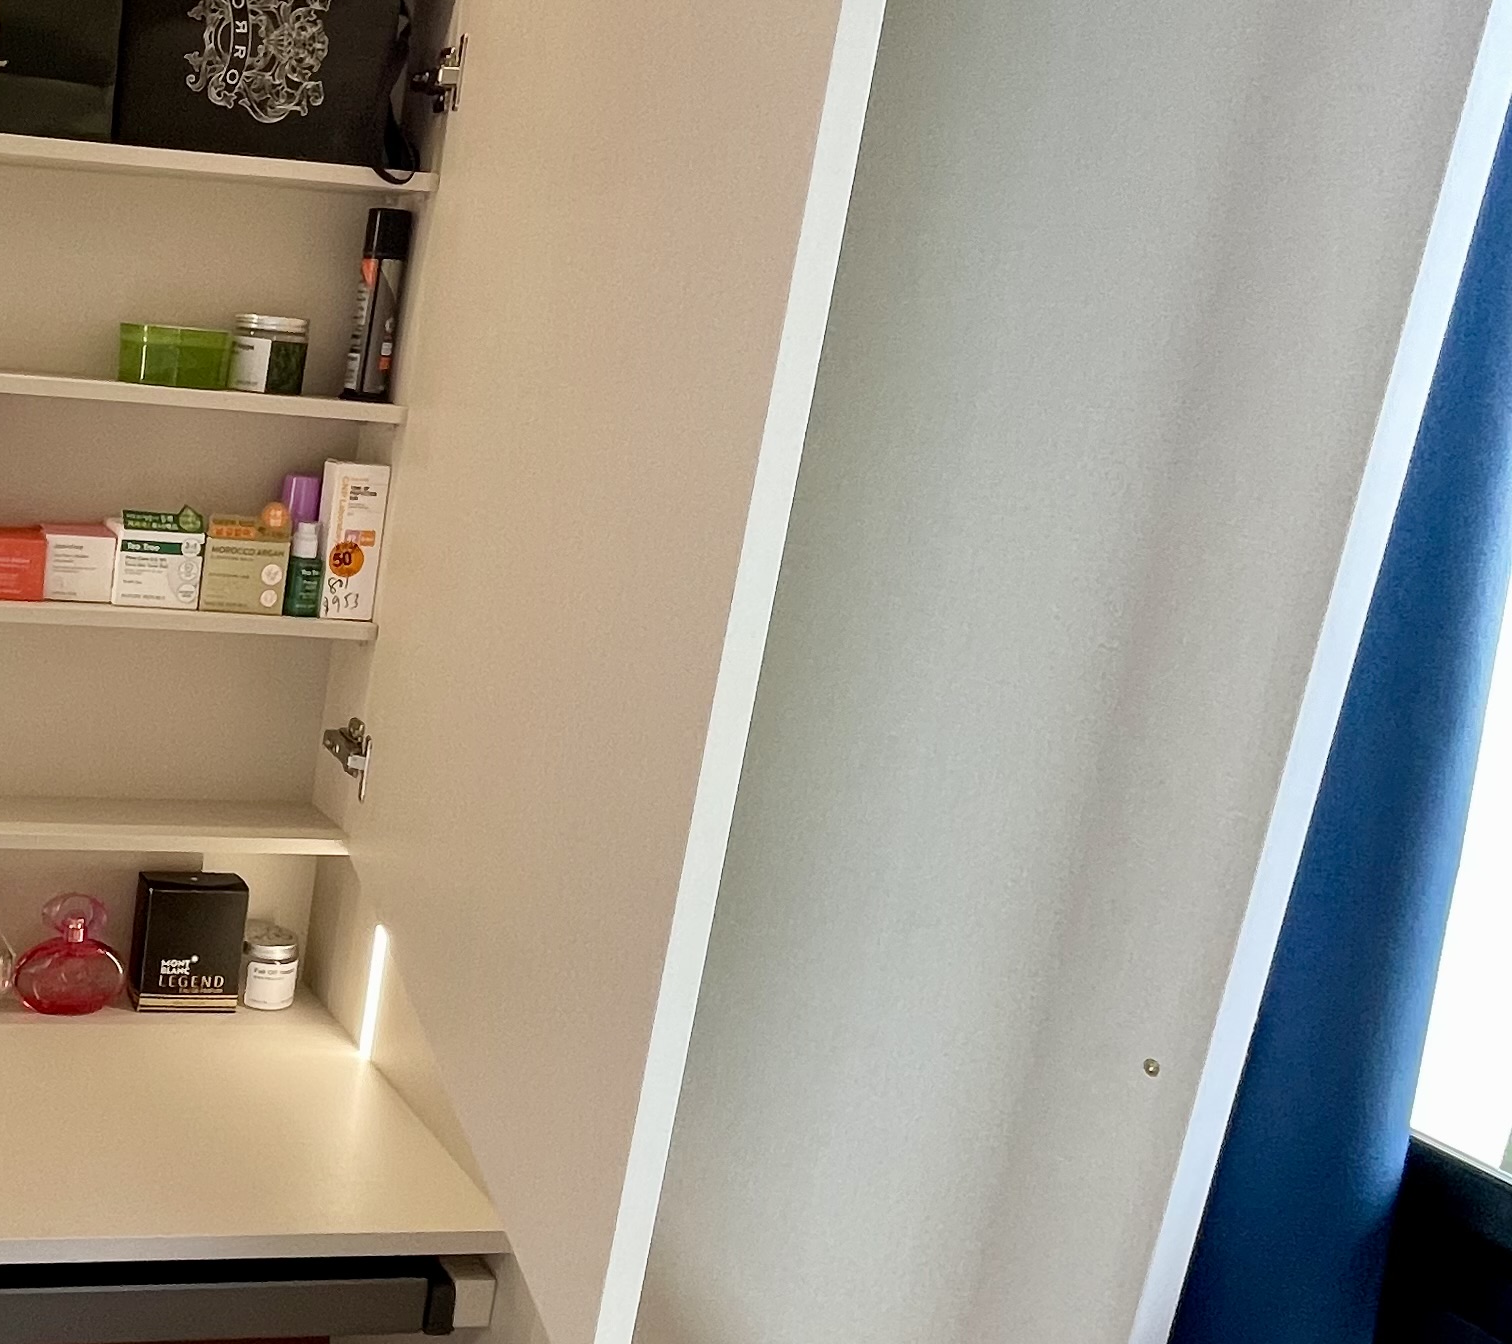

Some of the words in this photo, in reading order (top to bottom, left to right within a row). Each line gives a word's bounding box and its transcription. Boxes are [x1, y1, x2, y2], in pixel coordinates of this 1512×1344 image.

[211, 545, 255, 556] MOROCCO
[256, 549, 286, 557] ARGAN
[332, 552, 353, 568] 50
[160, 959, 191, 970] MONT
[160, 966, 190, 975] BLANC
[158, 974, 225, 988] LEGEND
